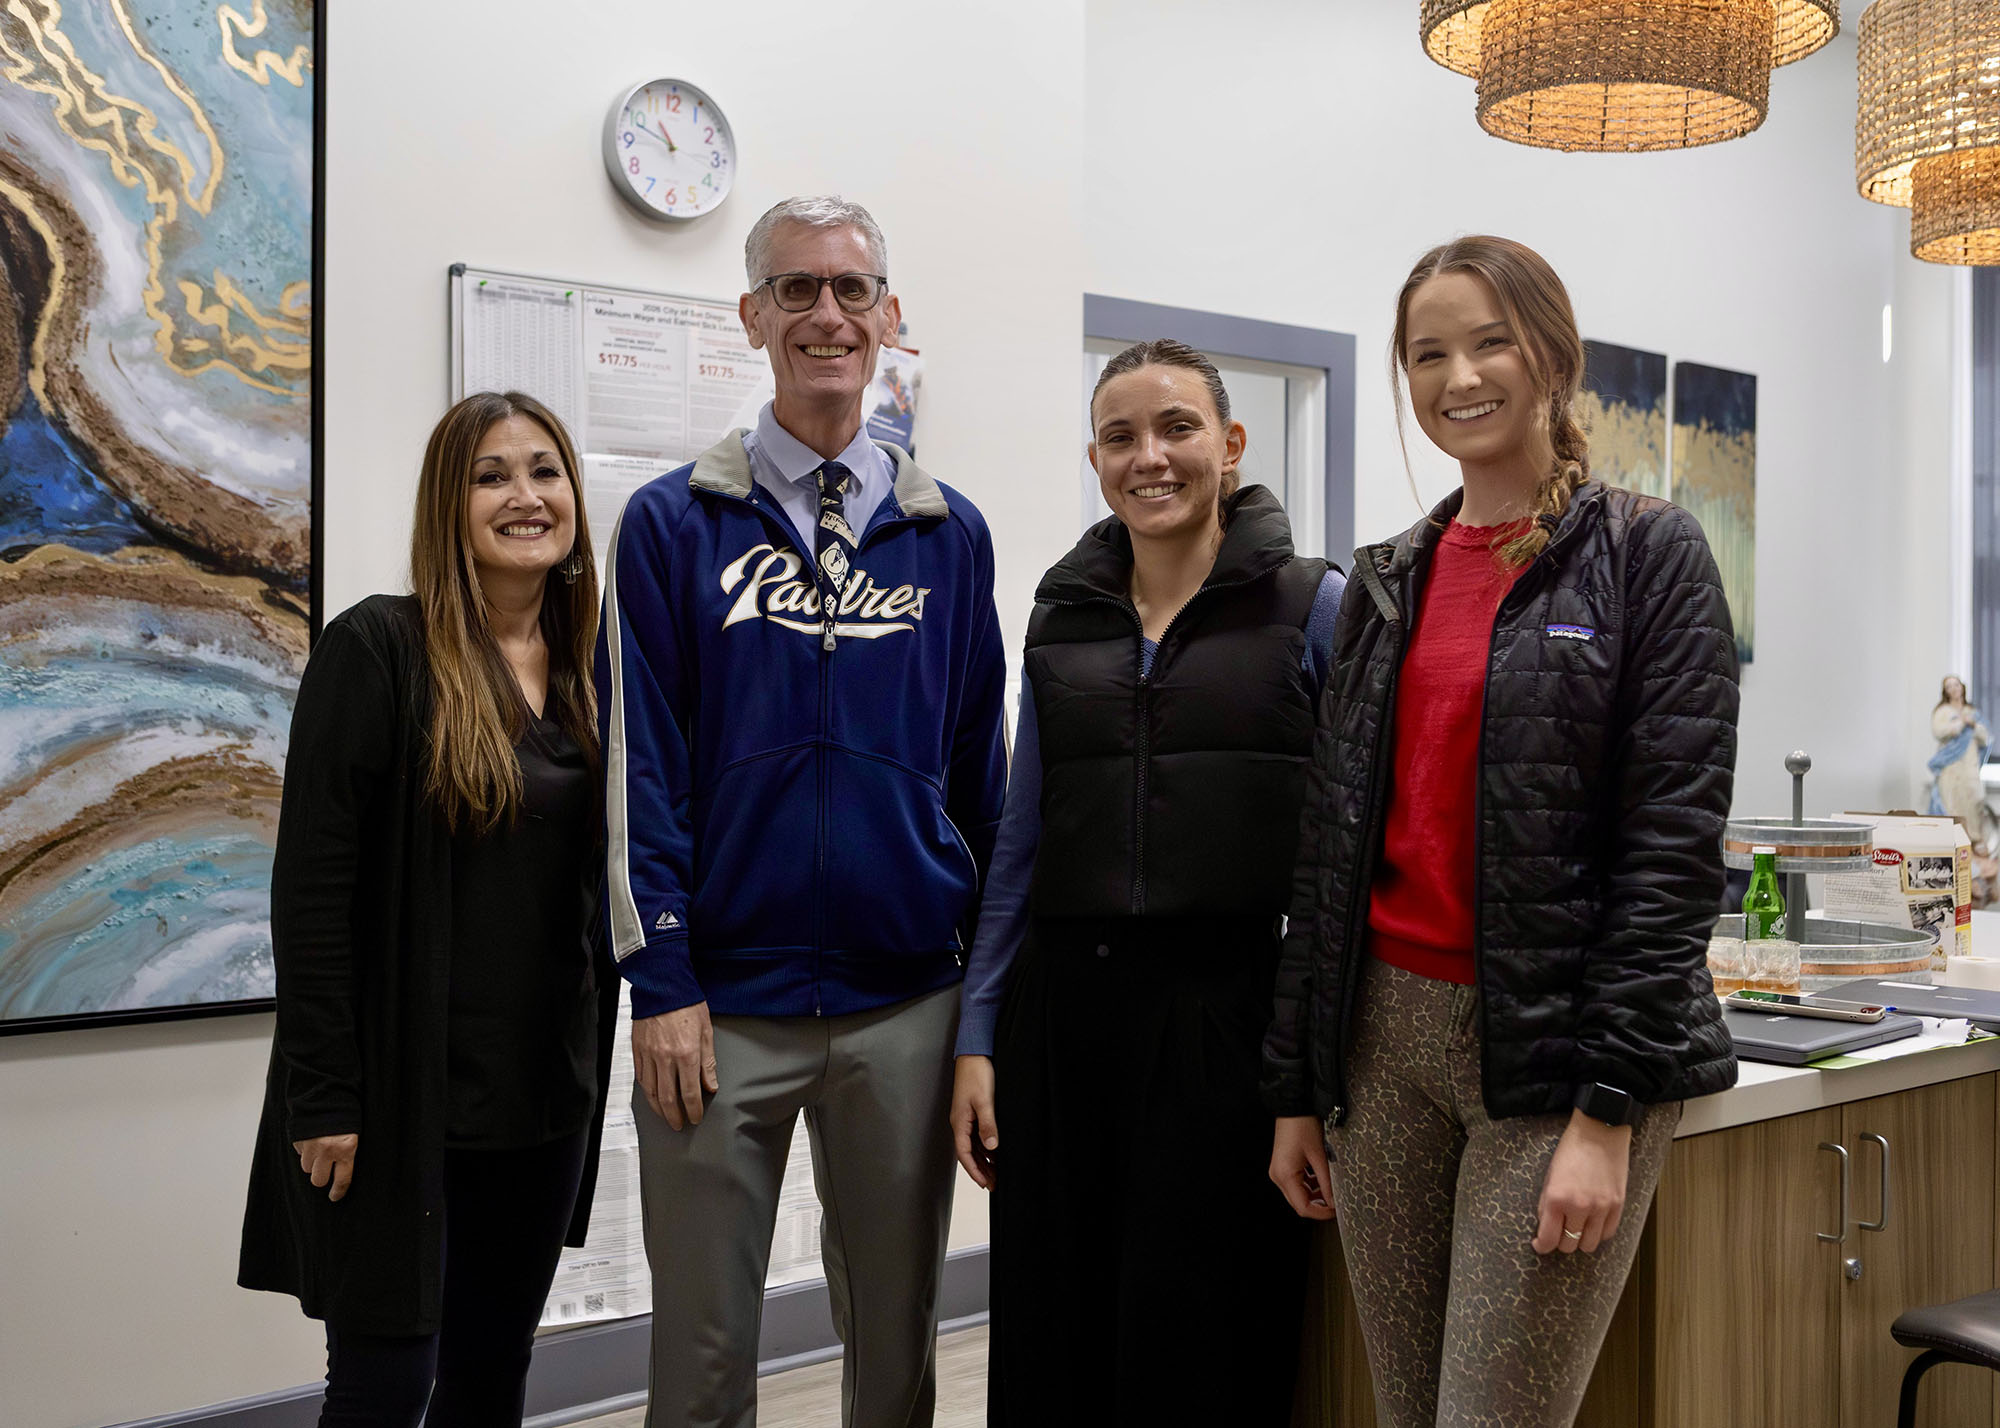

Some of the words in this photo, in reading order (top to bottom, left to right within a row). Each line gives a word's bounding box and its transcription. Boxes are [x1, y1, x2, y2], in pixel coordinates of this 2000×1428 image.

[648, 95, 660, 115] 11
[666, 93, 682, 113] 12
[630, 110, 646, 127] 10
[693, 105, 698, 124] 1
[623, 131, 635, 149] 9
[704, 126, 714, 145] 2
[629, 156, 640, 175] 8
[710, 151, 721, 168] 3
[645, 176, 657, 193] 7
[701, 173, 712, 187] 4
[665, 187, 677, 206] 6
[687, 185, 697, 204] 5
[595, 308, 632, 320] Minimum
[633, 311, 656, 323] Wage
[657, 315, 672, 325] and
[702, 319, 717, 330] Sick
[663, 306, 678, 316] City
[680, 308, 689, 316] of
[705, 311, 727, 322] Diego
[599, 352, 638, 368] $17.75
[698, 364, 735, 379] $17.75
[1872, 849, 1901, 862] Streit's
